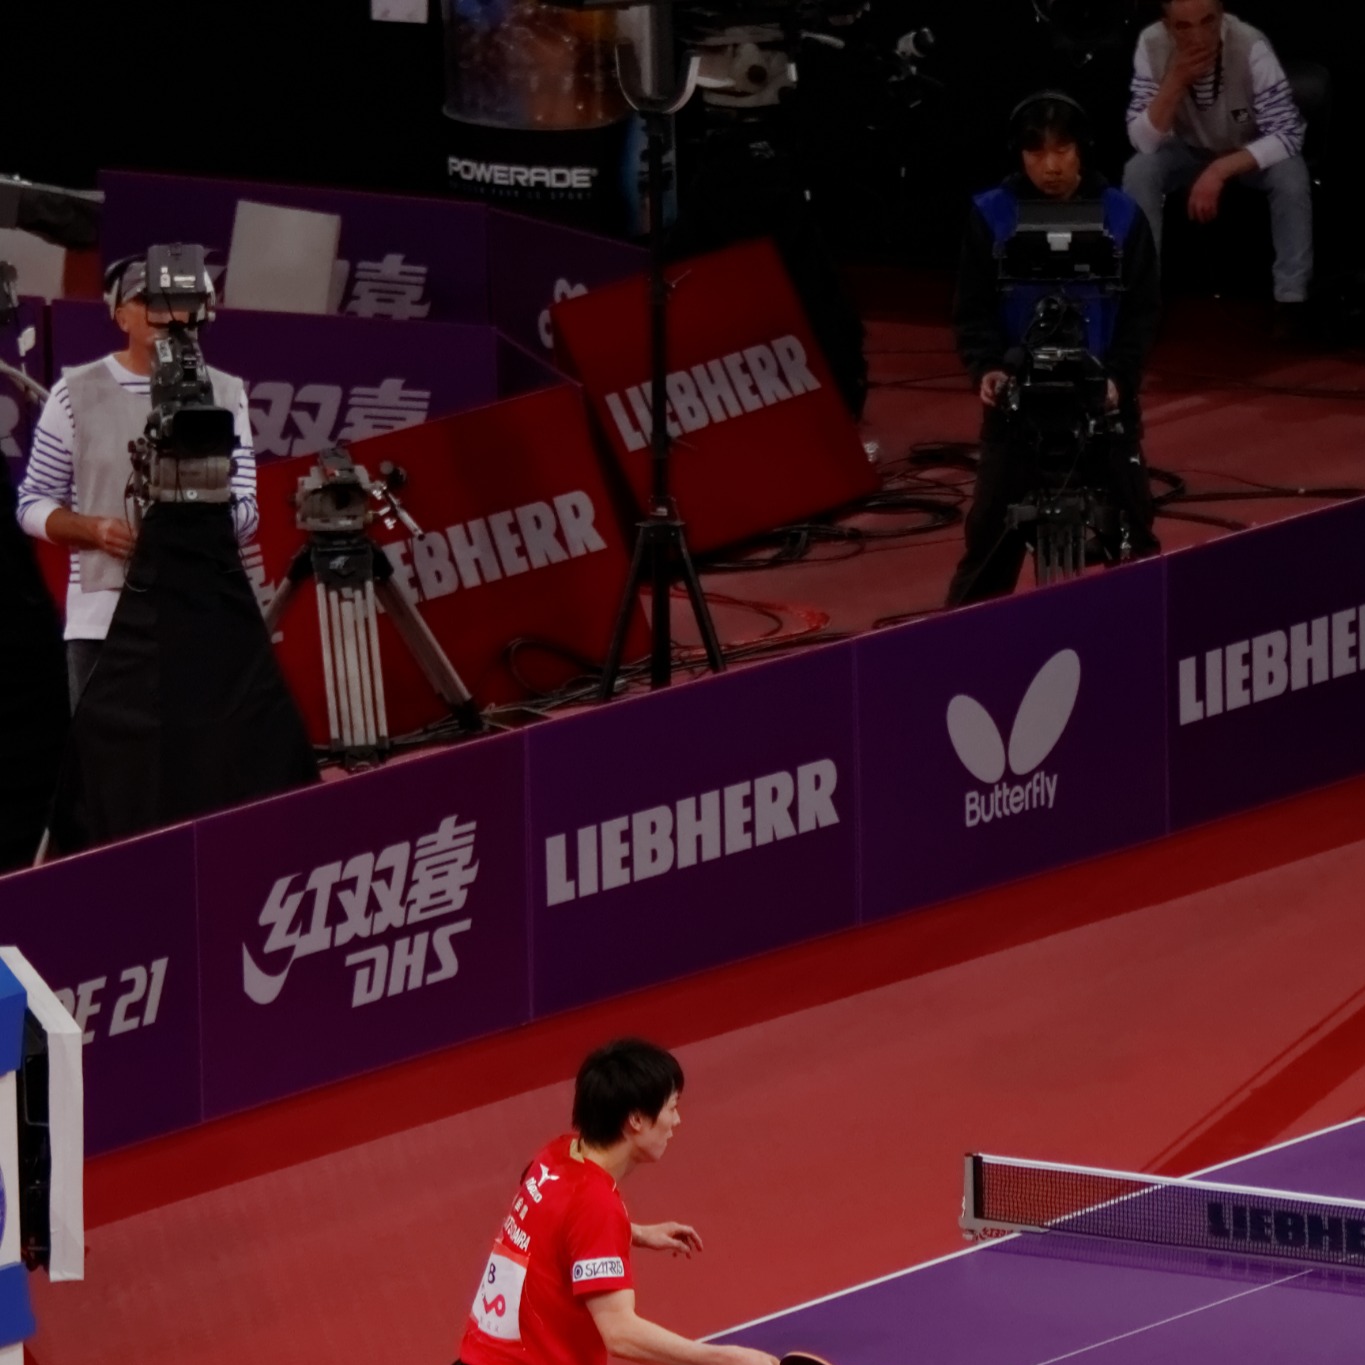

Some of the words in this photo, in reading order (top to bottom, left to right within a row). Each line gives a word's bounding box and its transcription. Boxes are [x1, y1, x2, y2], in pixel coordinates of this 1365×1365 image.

[446, 155, 593, 189] POWERADE
[249, 377, 431, 457] 双喜
[376, 489, 608, 615] EBHERR
[545, 758, 841, 908] LIEBHERR
[964, 770, 1058, 828] Butterfly
[242, 814, 480, 1005] 红双喜
[108, 957, 169, 1037] 21
[344, 918, 472, 1008] DHS
